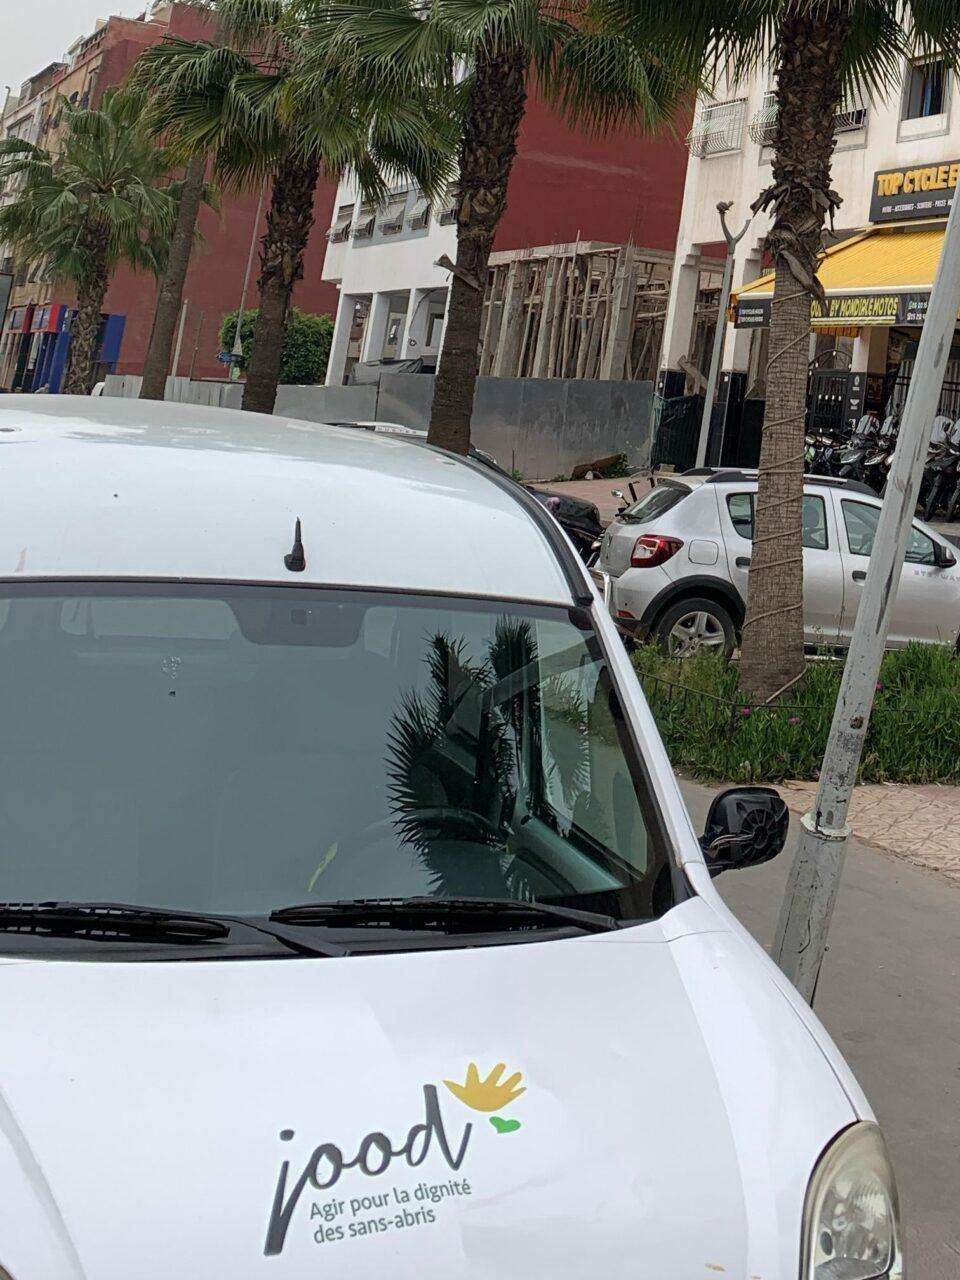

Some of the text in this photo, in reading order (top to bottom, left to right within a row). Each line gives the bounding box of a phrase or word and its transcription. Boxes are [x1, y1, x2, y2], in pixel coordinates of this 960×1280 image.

[877, 172, 904, 196] TOP
[903, 165, 950, 194] CYCLE
[309, 1178, 473, 1223] Agir pour la dignité
[312, 1206, 437, 1245] des sans-abris
